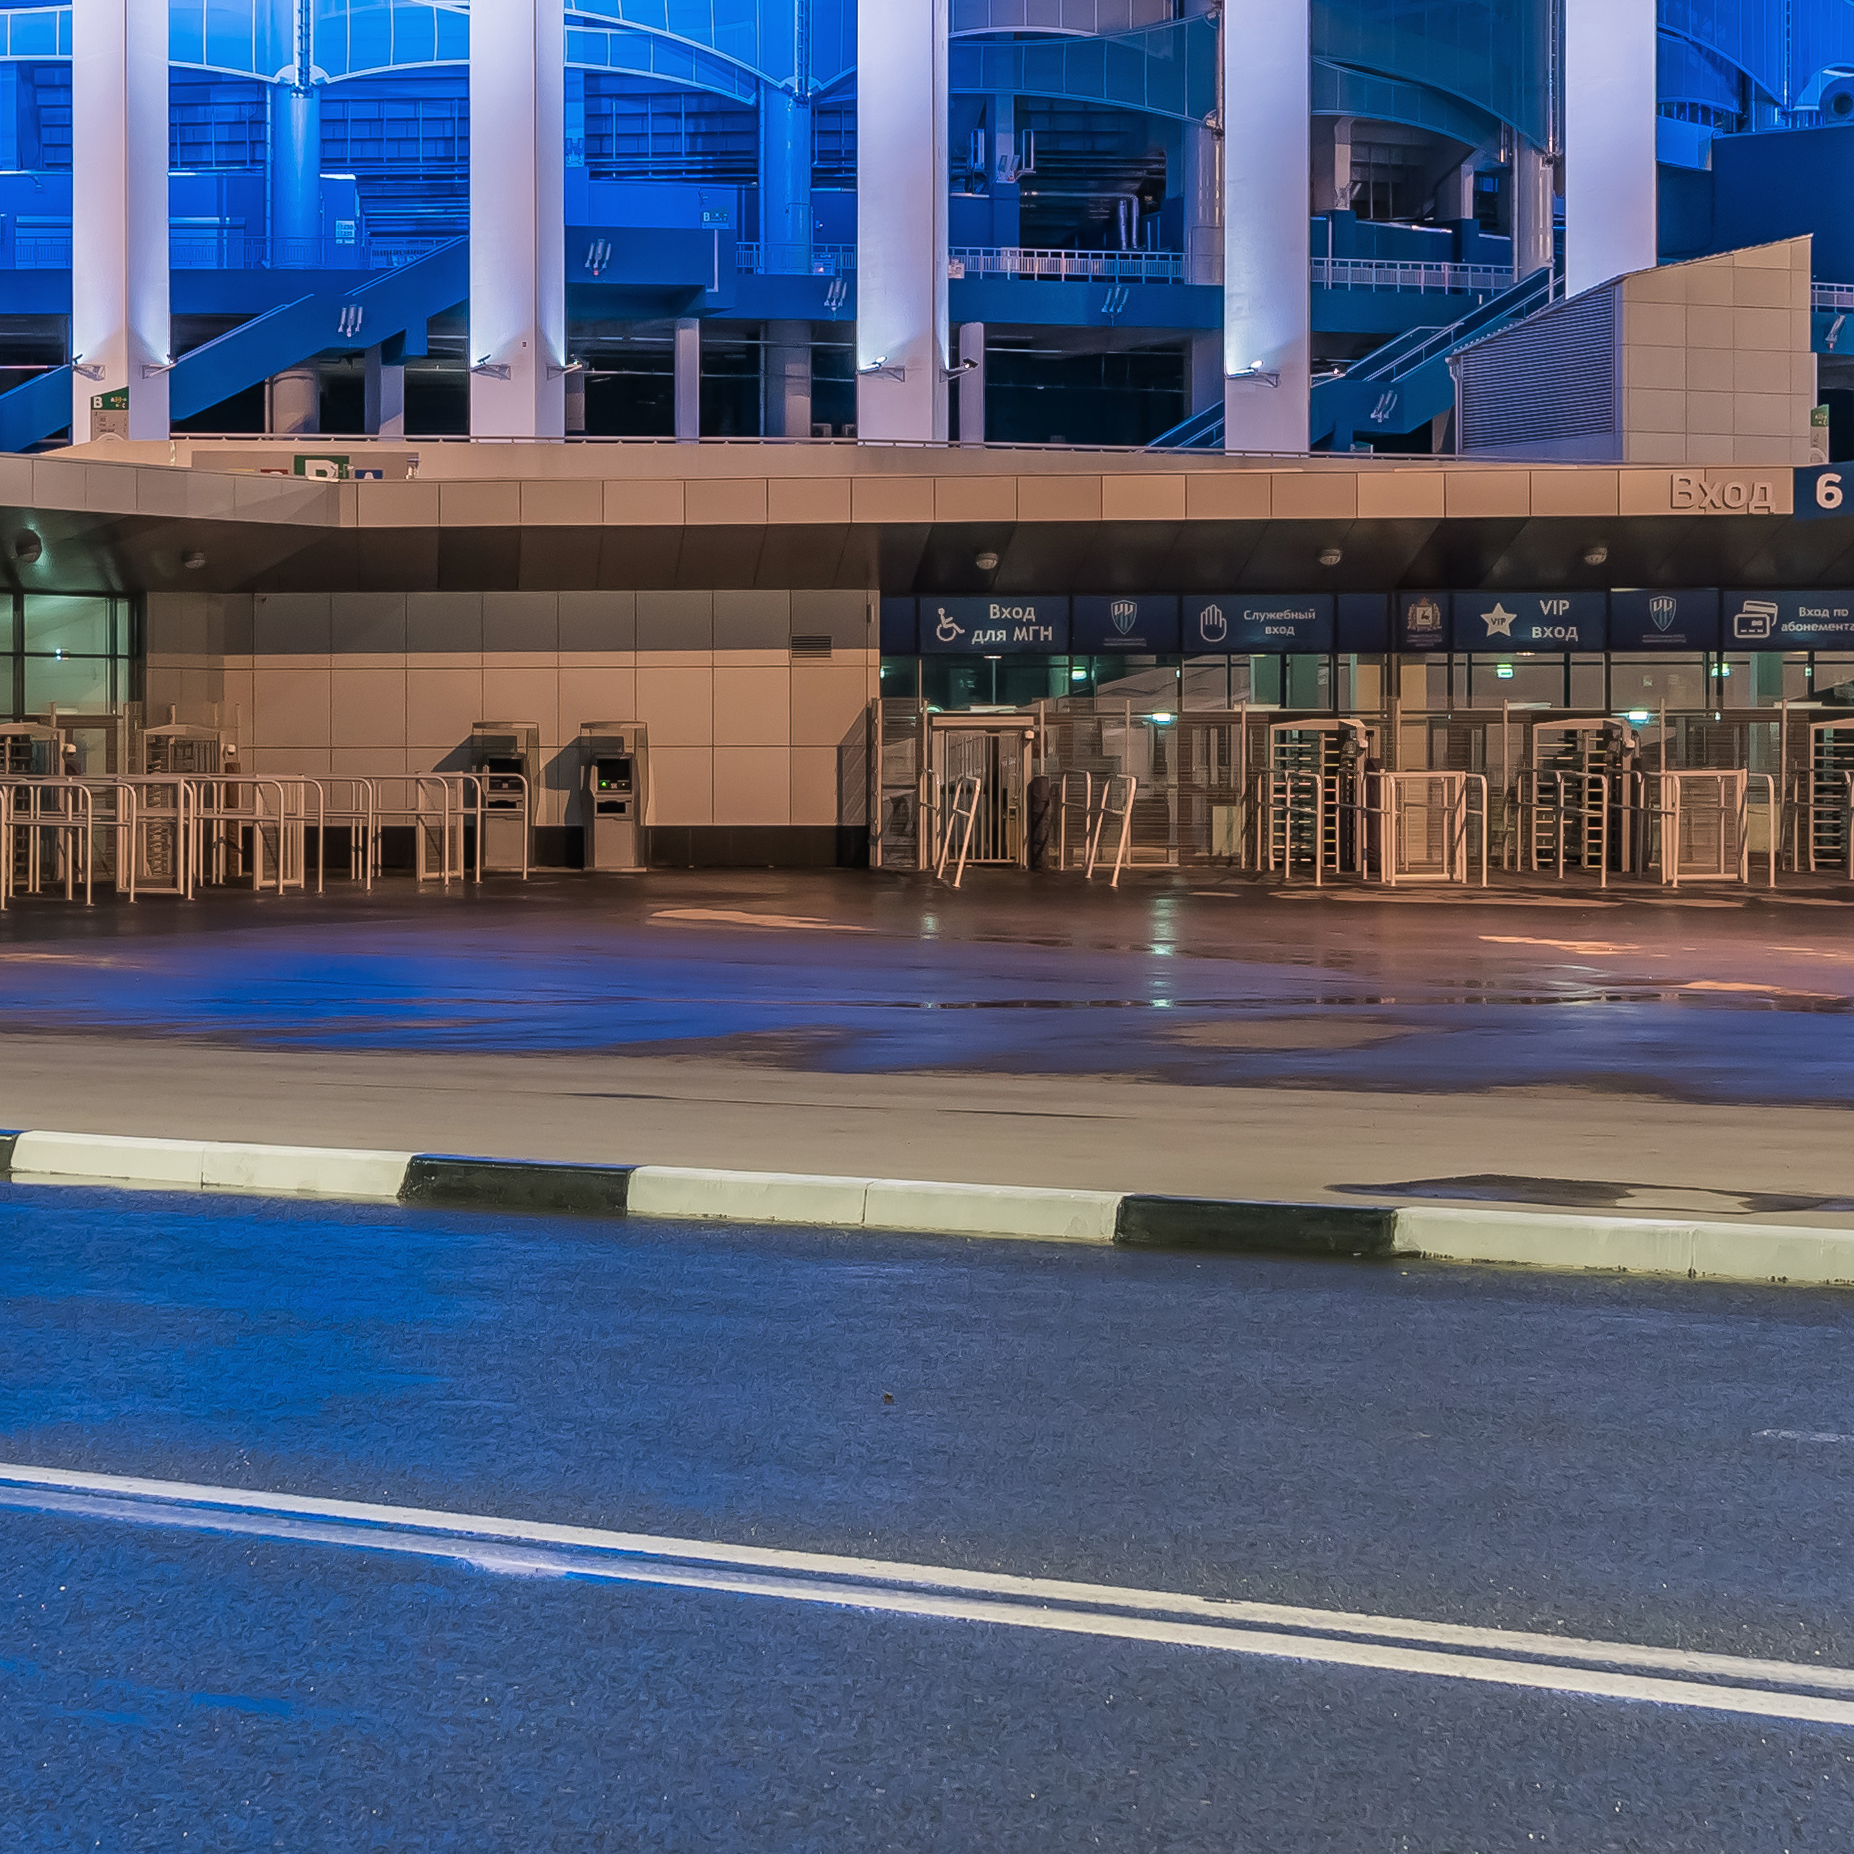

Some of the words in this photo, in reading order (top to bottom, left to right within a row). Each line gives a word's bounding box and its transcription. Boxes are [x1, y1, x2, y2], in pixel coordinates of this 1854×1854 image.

[93, 396, 103, 408] B
[1669, 473, 1776, 514] Вход
[1815, 472, 1843, 509] 6
[989, 604, 1036, 622] Вход
[1539, 599, 1570, 616] VIP
[1798, 606, 1829, 620] Вход
[1833, 608, 1849, 618] по
[1243, 609, 1317, 623] Служебный
[1490, 617, 1506, 627] VIP
[972, 629, 1008, 645] для
[1013, 626, 1054, 642] МГН
